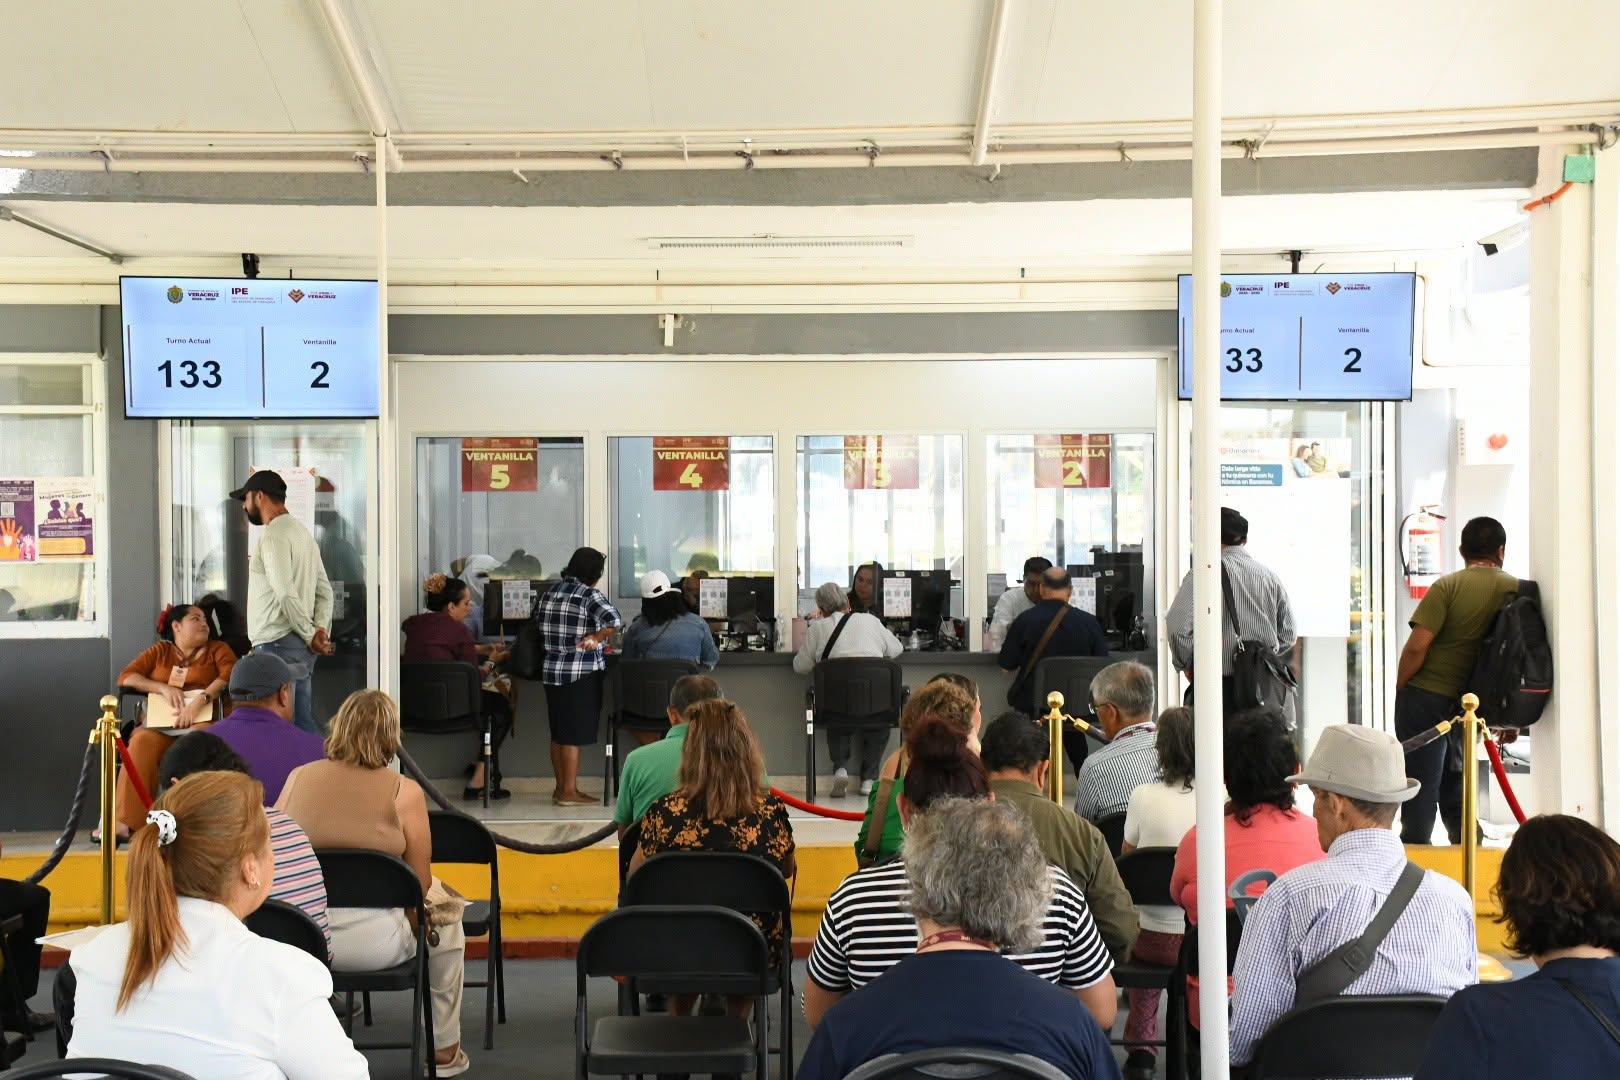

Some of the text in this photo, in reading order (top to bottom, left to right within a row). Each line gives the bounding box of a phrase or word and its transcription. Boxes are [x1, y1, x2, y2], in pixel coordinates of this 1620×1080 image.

[231, 287, 249, 295] IPE
[1274, 281, 1290, 289] IPE
[1225, 347, 1263, 373] 33
[1343, 347, 1362, 373] 2
[157, 360, 222, 388] 133
[310, 361, 330, 388] 2
[465, 452, 534, 461] VENTANILLA
[656, 451, 725, 460] VENTANILLA
[1038, 448, 1106, 457] VENTANILLA
[489, 464, 511, 490] 5
[679, 463, 703, 488] 4
[871, 462, 892, 487] 3
[1062, 460, 1083, 486] 2
